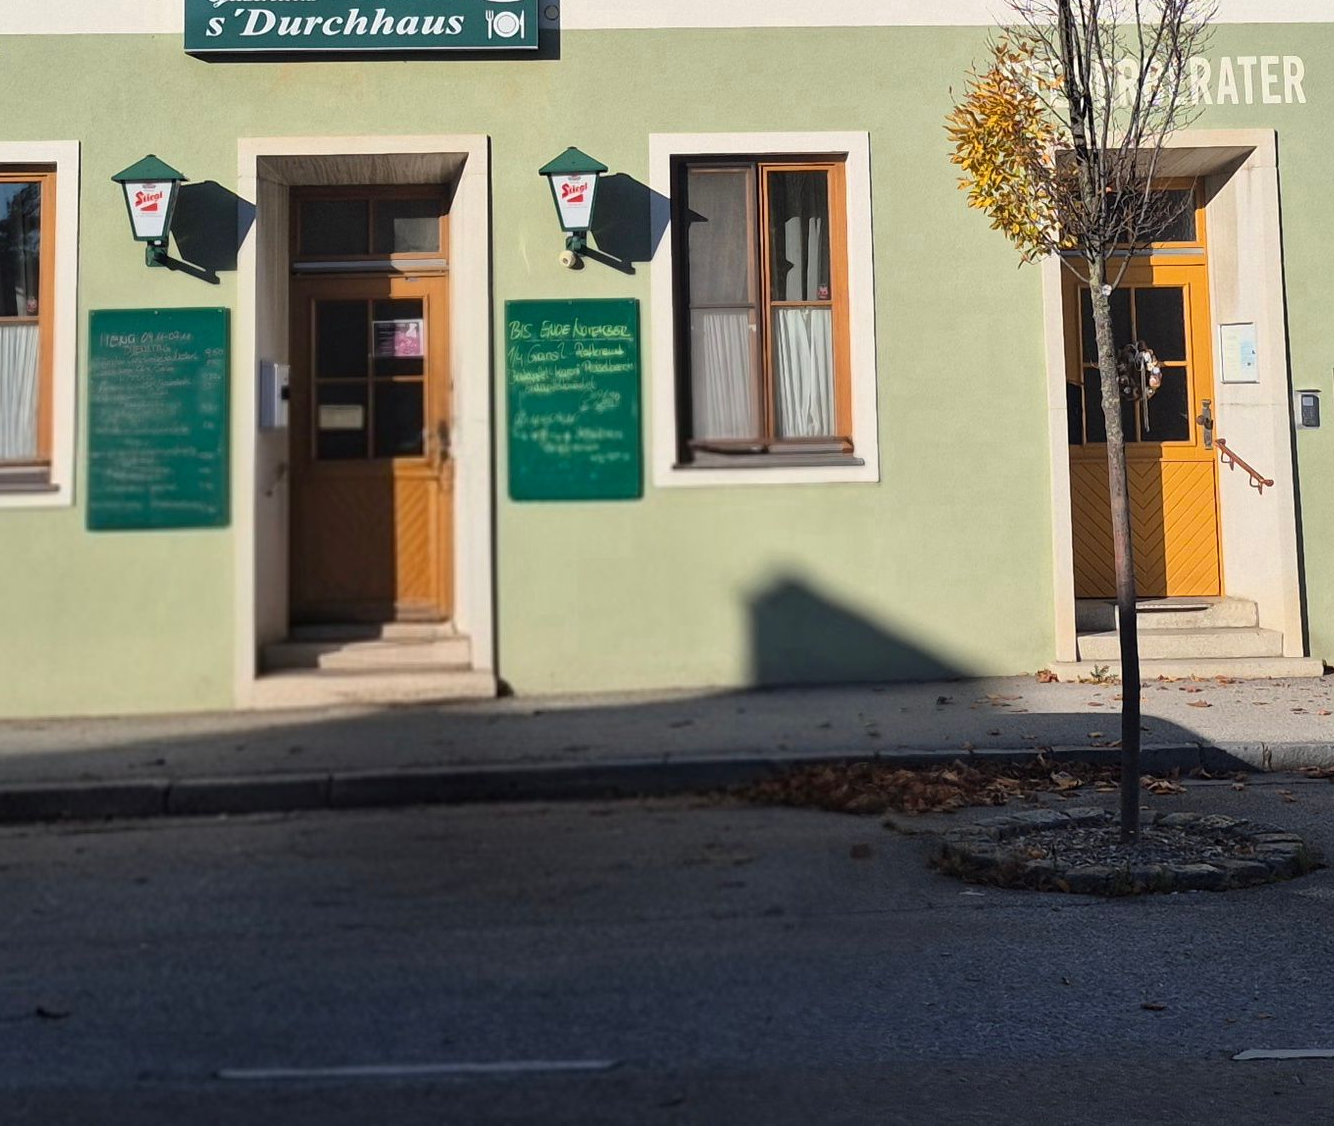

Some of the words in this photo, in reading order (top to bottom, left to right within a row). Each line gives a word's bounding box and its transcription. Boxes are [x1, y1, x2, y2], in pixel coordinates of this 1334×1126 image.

[135, 190, 163, 207] Stiegl
[562, 182, 588, 199] Stiegl
[509, 320, 533, 340] BIS
[540, 320, 571, 338] ENDE
